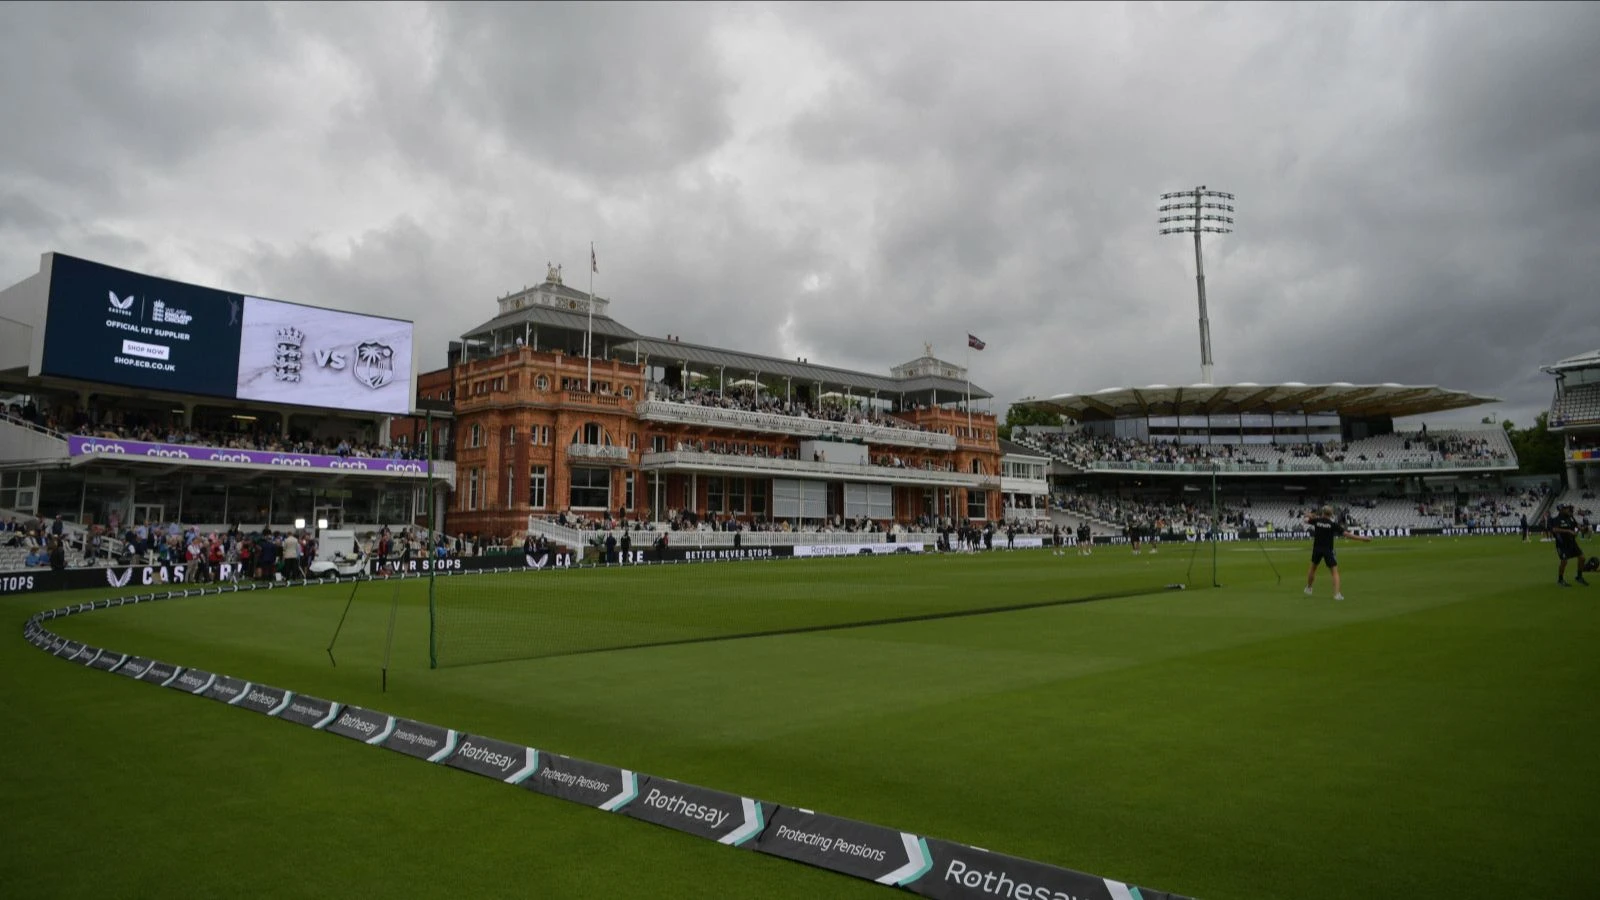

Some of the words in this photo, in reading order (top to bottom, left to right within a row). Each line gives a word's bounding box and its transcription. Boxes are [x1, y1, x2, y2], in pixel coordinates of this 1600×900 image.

[106, 320, 139, 332] OFFICIAL
[141, 326, 153, 334] KIT
[155, 329, 190, 340] SUPPLIER
[128, 344, 145, 352] SHOP
[147, 347, 165, 355] NOW
[312, 350, 346, 370] VS
[114, 356, 175, 371] SHOP.ECB.CO.UK
[81, 438, 125, 455] cinch
[147, 445, 189, 459] cinch
[210, 450, 251, 464] cinch
[271, 455, 310, 467] cinch
[329, 459, 368, 471] cinch
[1358, 528, 1411, 538] CASTORE
[685, 551, 716, 560] BETTER
[719, 549, 745, 558] NEVER
[747, 548, 773, 557] STOPS
[0, 576, 34, 592] TOPS
[338, 713, 380, 737] Rothesay
[457, 741, 516, 771] Rothesay
[540, 766, 577, 787] Protecting
[576, 775, 610, 795] Pensions
[643, 788, 730, 829] Rothesay
[776, 824, 833, 852] Protecting
[832, 838, 887, 862] Pensions
[944, 859, 1089, 900] Rothes
